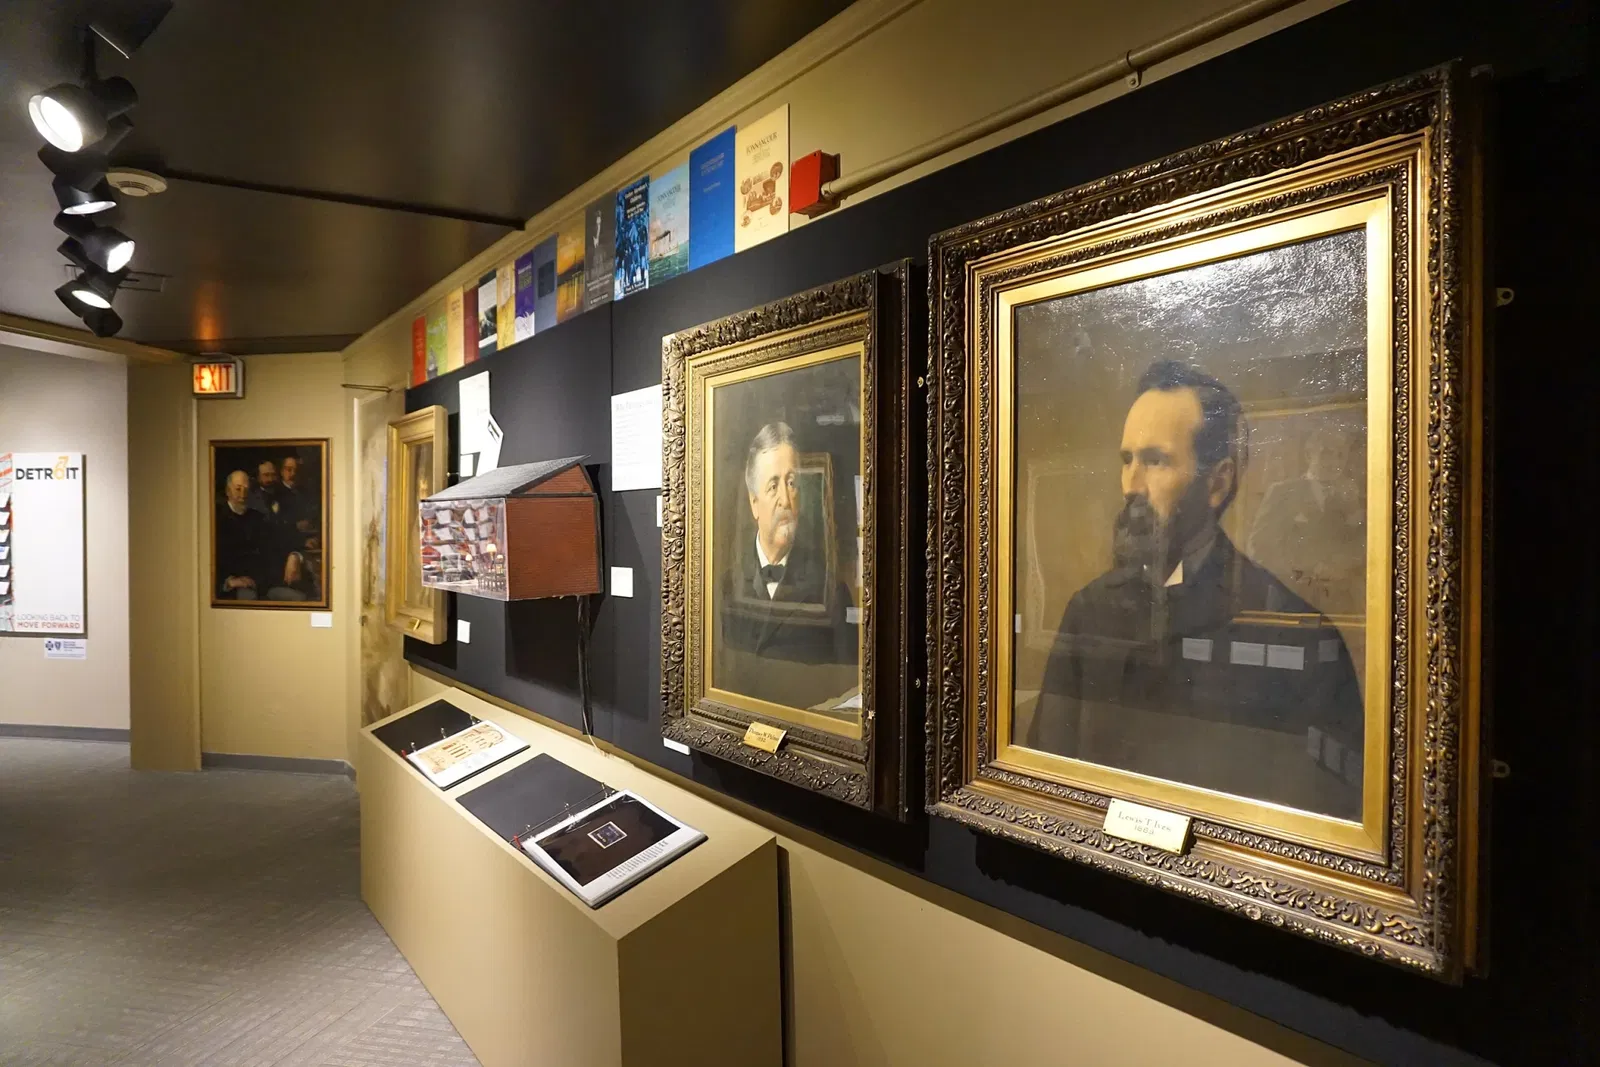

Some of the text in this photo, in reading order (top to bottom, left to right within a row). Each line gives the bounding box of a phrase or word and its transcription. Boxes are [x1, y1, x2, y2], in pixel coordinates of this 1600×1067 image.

[198, 364, 232, 391] EXIT
[50, 614, 68, 622] BACK
[71, 614, 80, 622] TO
[17, 621, 80, 629] MOVE FORWARD
[1118, 811, 1143, 824] Lewis
